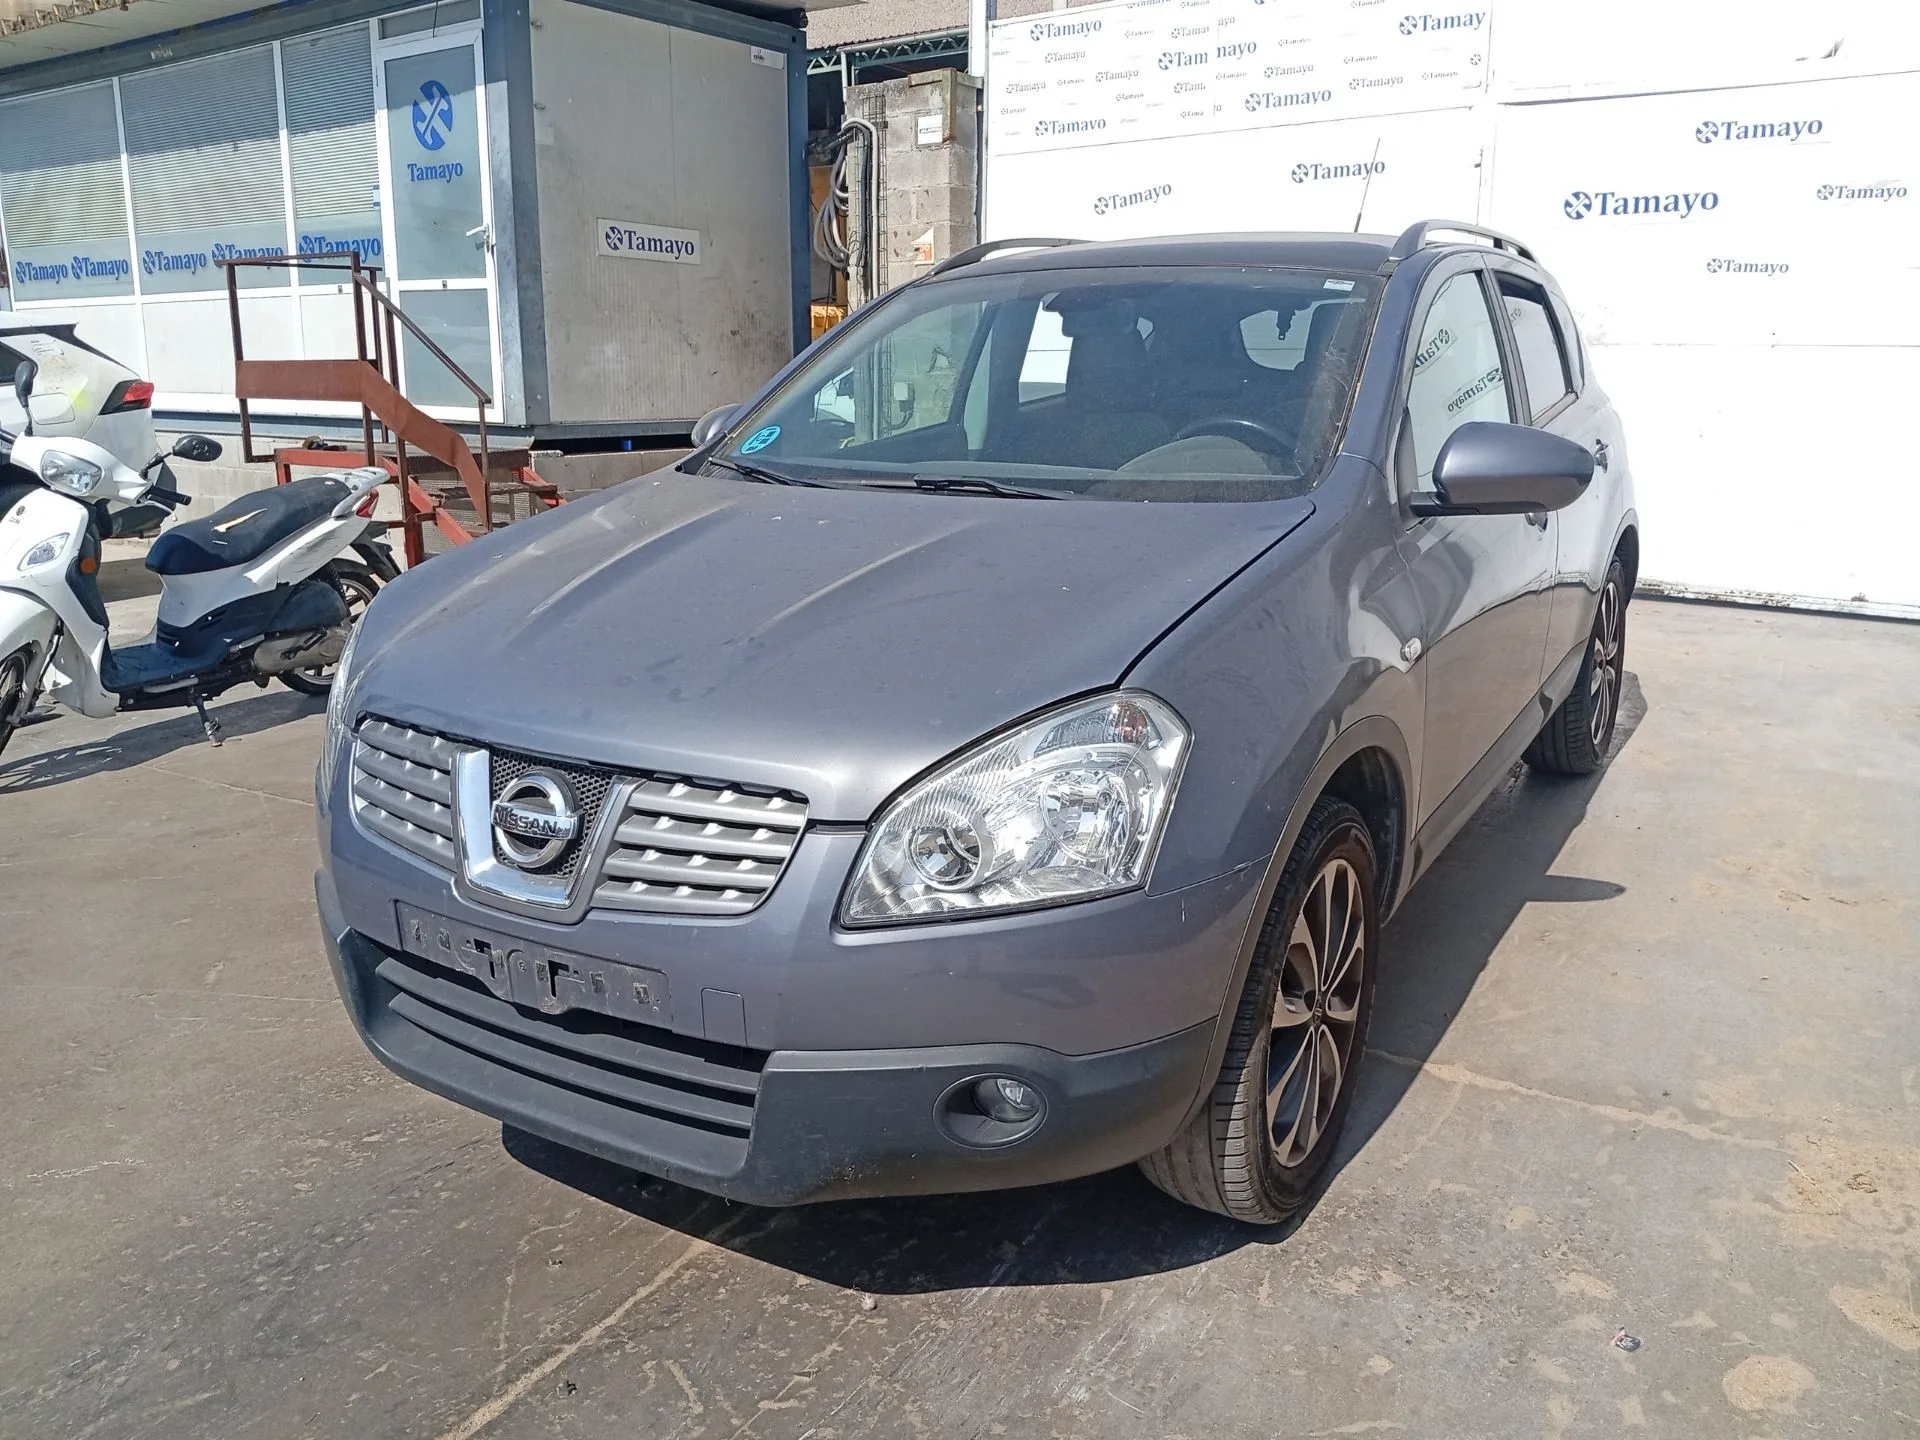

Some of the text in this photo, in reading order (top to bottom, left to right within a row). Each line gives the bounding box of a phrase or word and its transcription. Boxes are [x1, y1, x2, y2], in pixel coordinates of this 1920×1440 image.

[1045, 19, 1102, 38] Tamayo
[1419, 12, 1486, 31] Tamay
[1053, 50, 1086, 64] Tamayo
[1104, 68, 1140, 82] Tamayo
[1274, 64, 1315, 79] Tamayo
[1360, 75, 1404, 90] Tamayo
[1720, 118, 1824, 144] Tamayo
[407, 162, 464, 184] Tamayo
[1310, 160, 1386, 181] Tamayo
[1109, 183, 1172, 211] Tamayo
[1594, 190, 1720, 219] Tamayo
[1835, 184, 1908, 203] Tamayo
[314, 235, 382, 264] Tamayo
[624, 229, 695, 260] Tamayo
[25, 262, 69, 284] Tamayo
[81, 257, 129, 280] Tamayo
[154, 251, 207, 275] Tamayo
[1723, 259, 1790, 277] Tamayo
[494, 806, 559, 835] NISSAN
